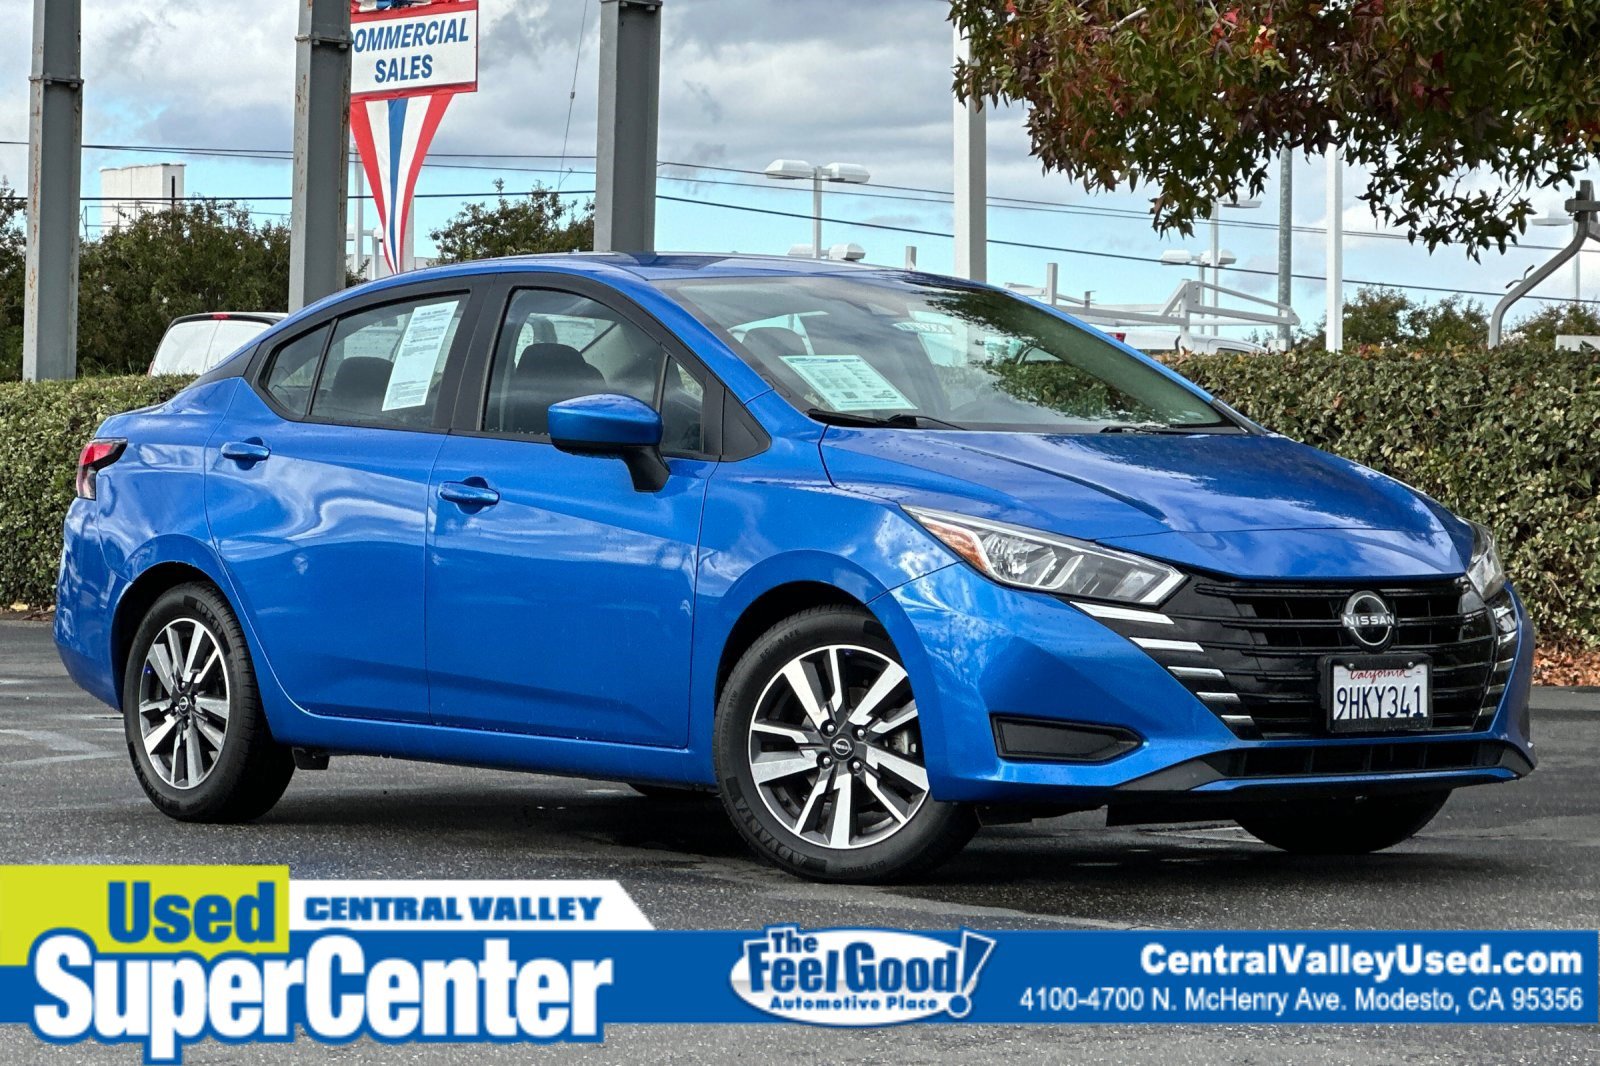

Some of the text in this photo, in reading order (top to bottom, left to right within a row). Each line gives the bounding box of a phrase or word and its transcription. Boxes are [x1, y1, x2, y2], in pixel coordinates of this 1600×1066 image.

[351, 18, 469, 53] OMMERCIAL
[374, 54, 433, 83] SALES
[1343, 614, 1395, 626] NISSAN
[1336, 685, 1424, 719] 9HKY341
